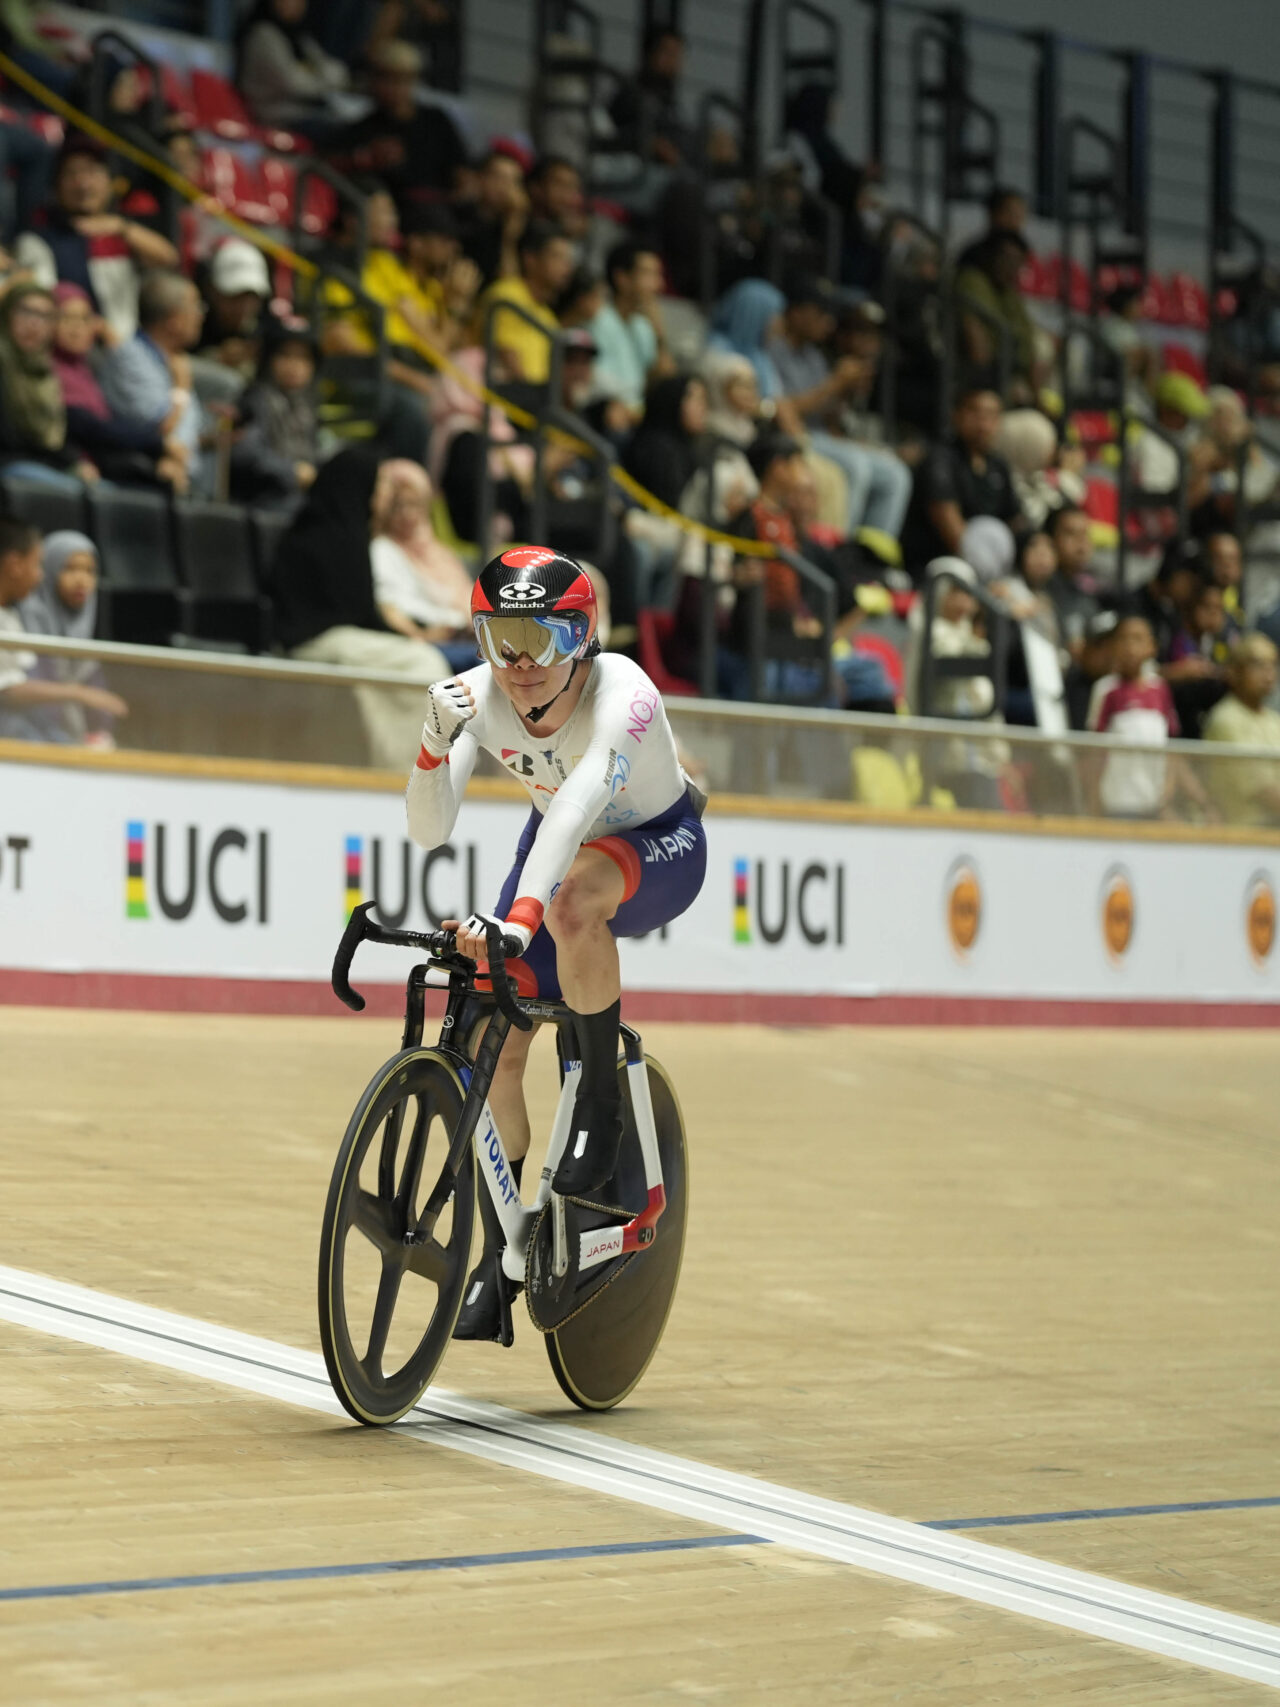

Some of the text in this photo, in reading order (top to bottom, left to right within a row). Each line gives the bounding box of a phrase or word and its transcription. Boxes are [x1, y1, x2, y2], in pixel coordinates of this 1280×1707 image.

[500, 601, 545, 609] Kabuto
[603, 747, 617, 787] KEIRIN
[153, 820, 269, 925] UCI
[642, 826, 697, 863] JAPAN
[371, 836, 479, 930] UCI
[754, 858, 846, 947] UCI
[484, 1128, 515, 1205] TORAY
[586, 1240, 620, 1258] JAPAN
